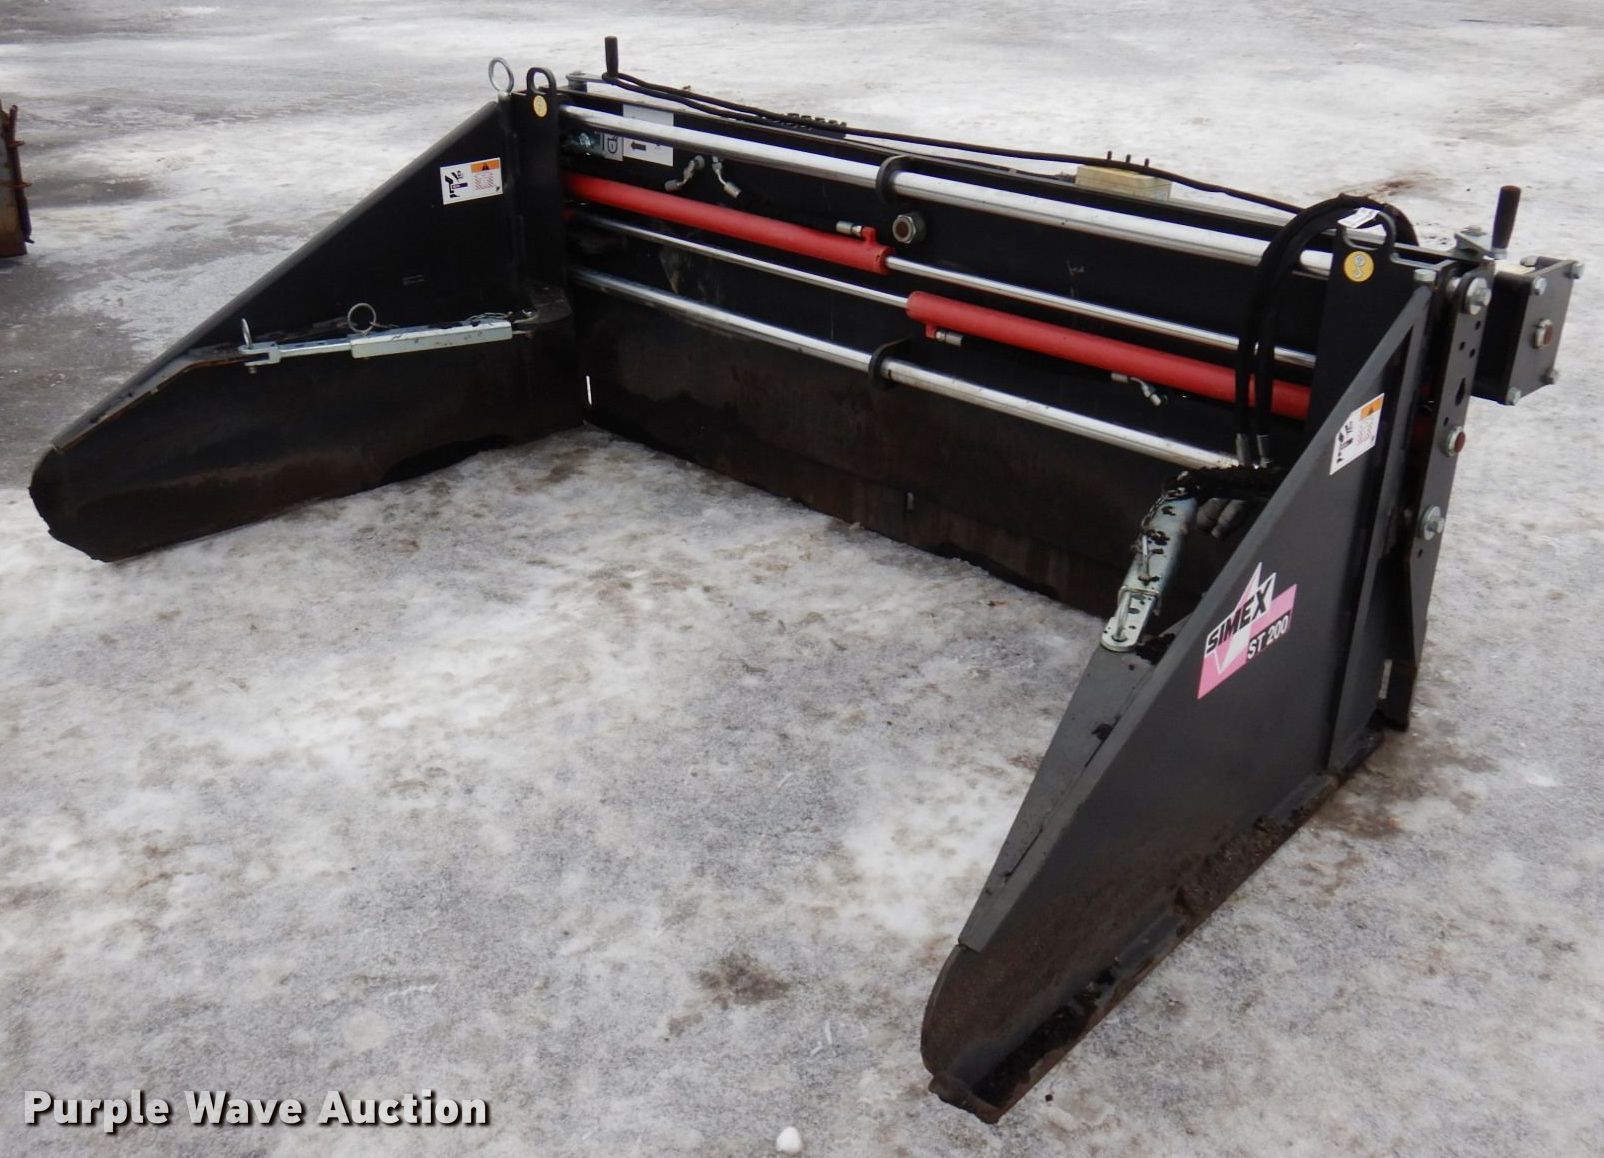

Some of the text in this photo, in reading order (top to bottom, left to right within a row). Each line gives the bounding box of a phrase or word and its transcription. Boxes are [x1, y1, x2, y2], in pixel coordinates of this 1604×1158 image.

[1206, 578, 1273, 654] SIMEX
[1247, 615, 1289, 660] ST 200
